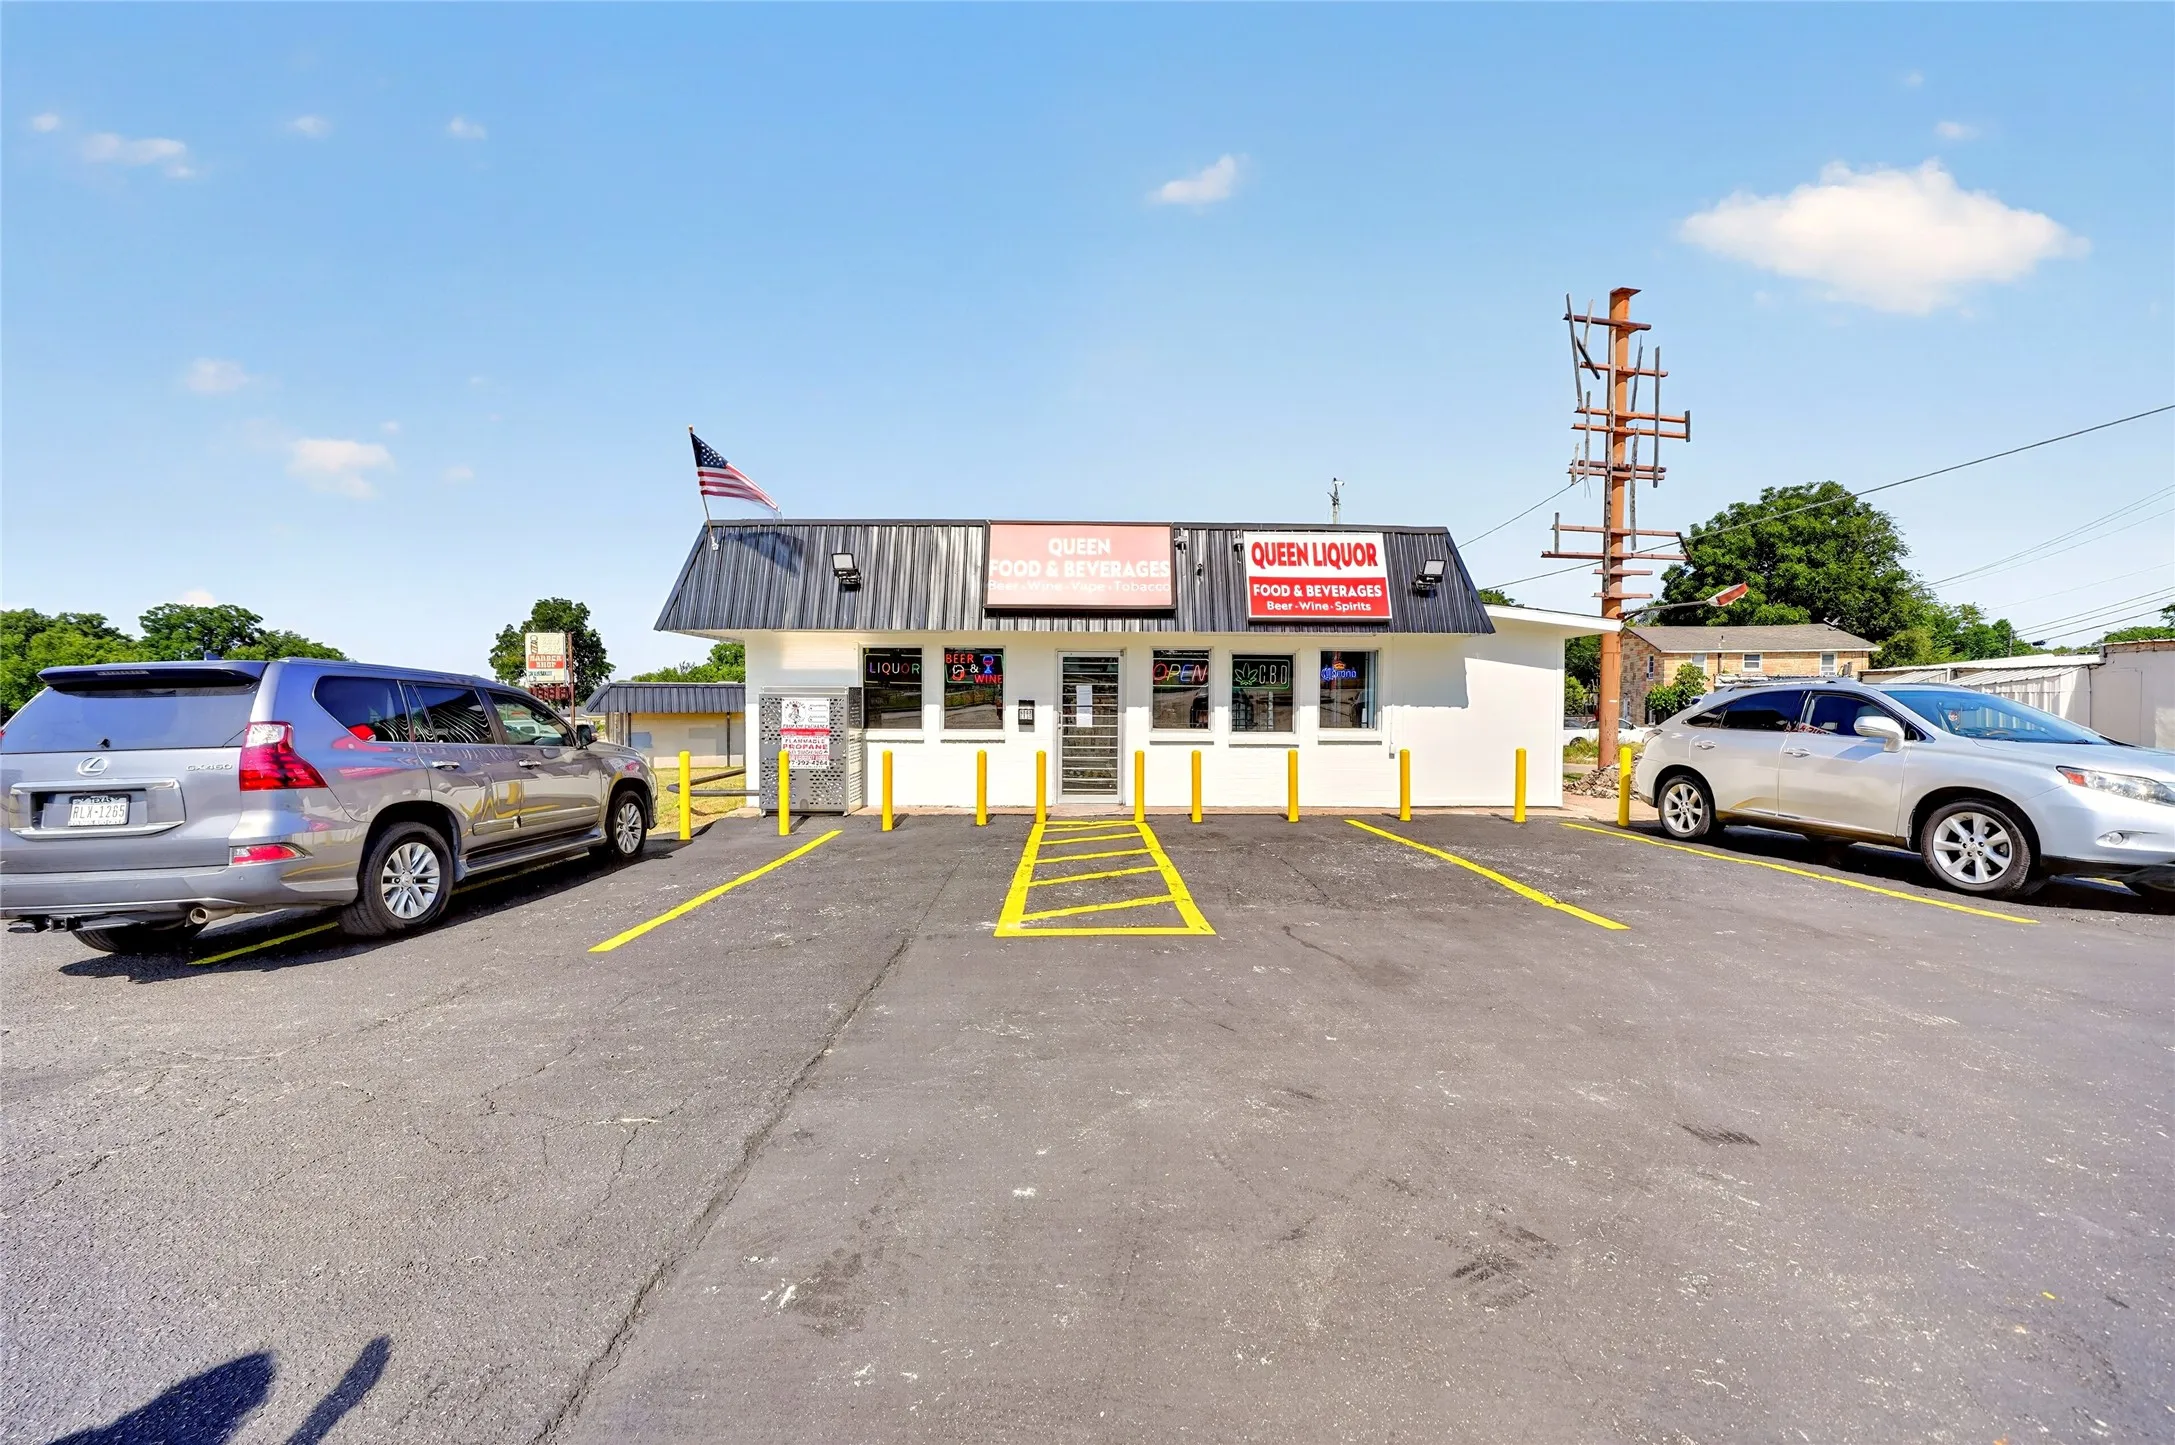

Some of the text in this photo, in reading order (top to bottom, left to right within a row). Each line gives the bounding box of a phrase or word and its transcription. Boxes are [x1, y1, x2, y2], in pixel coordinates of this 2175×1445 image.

[1048, 537, 1111, 557] QUEEN
[1251, 541, 1378, 570] QUEEN LIQUOR
[989, 560, 1170, 578] FOOD & BEVERAGES
[987, 581, 1171, 594] Beer Wine Vape Tobacco
[1253, 584, 1382, 598] FOOD & BEVERAGES
[1266, 601, 1372, 613] Beer Wine Spirits
[945, 653, 974, 664] BEER
[869, 662, 921, 675] LIQUOR
[969, 663, 979, 674] &
[1153, 663, 1208, 682] OPEN
[1259, 664, 1288, 685] CBD
[1321, 667, 1357, 681] Corona
[974, 674, 1003, 684] WINE
[90, 796, 112, 804] TEXAS
